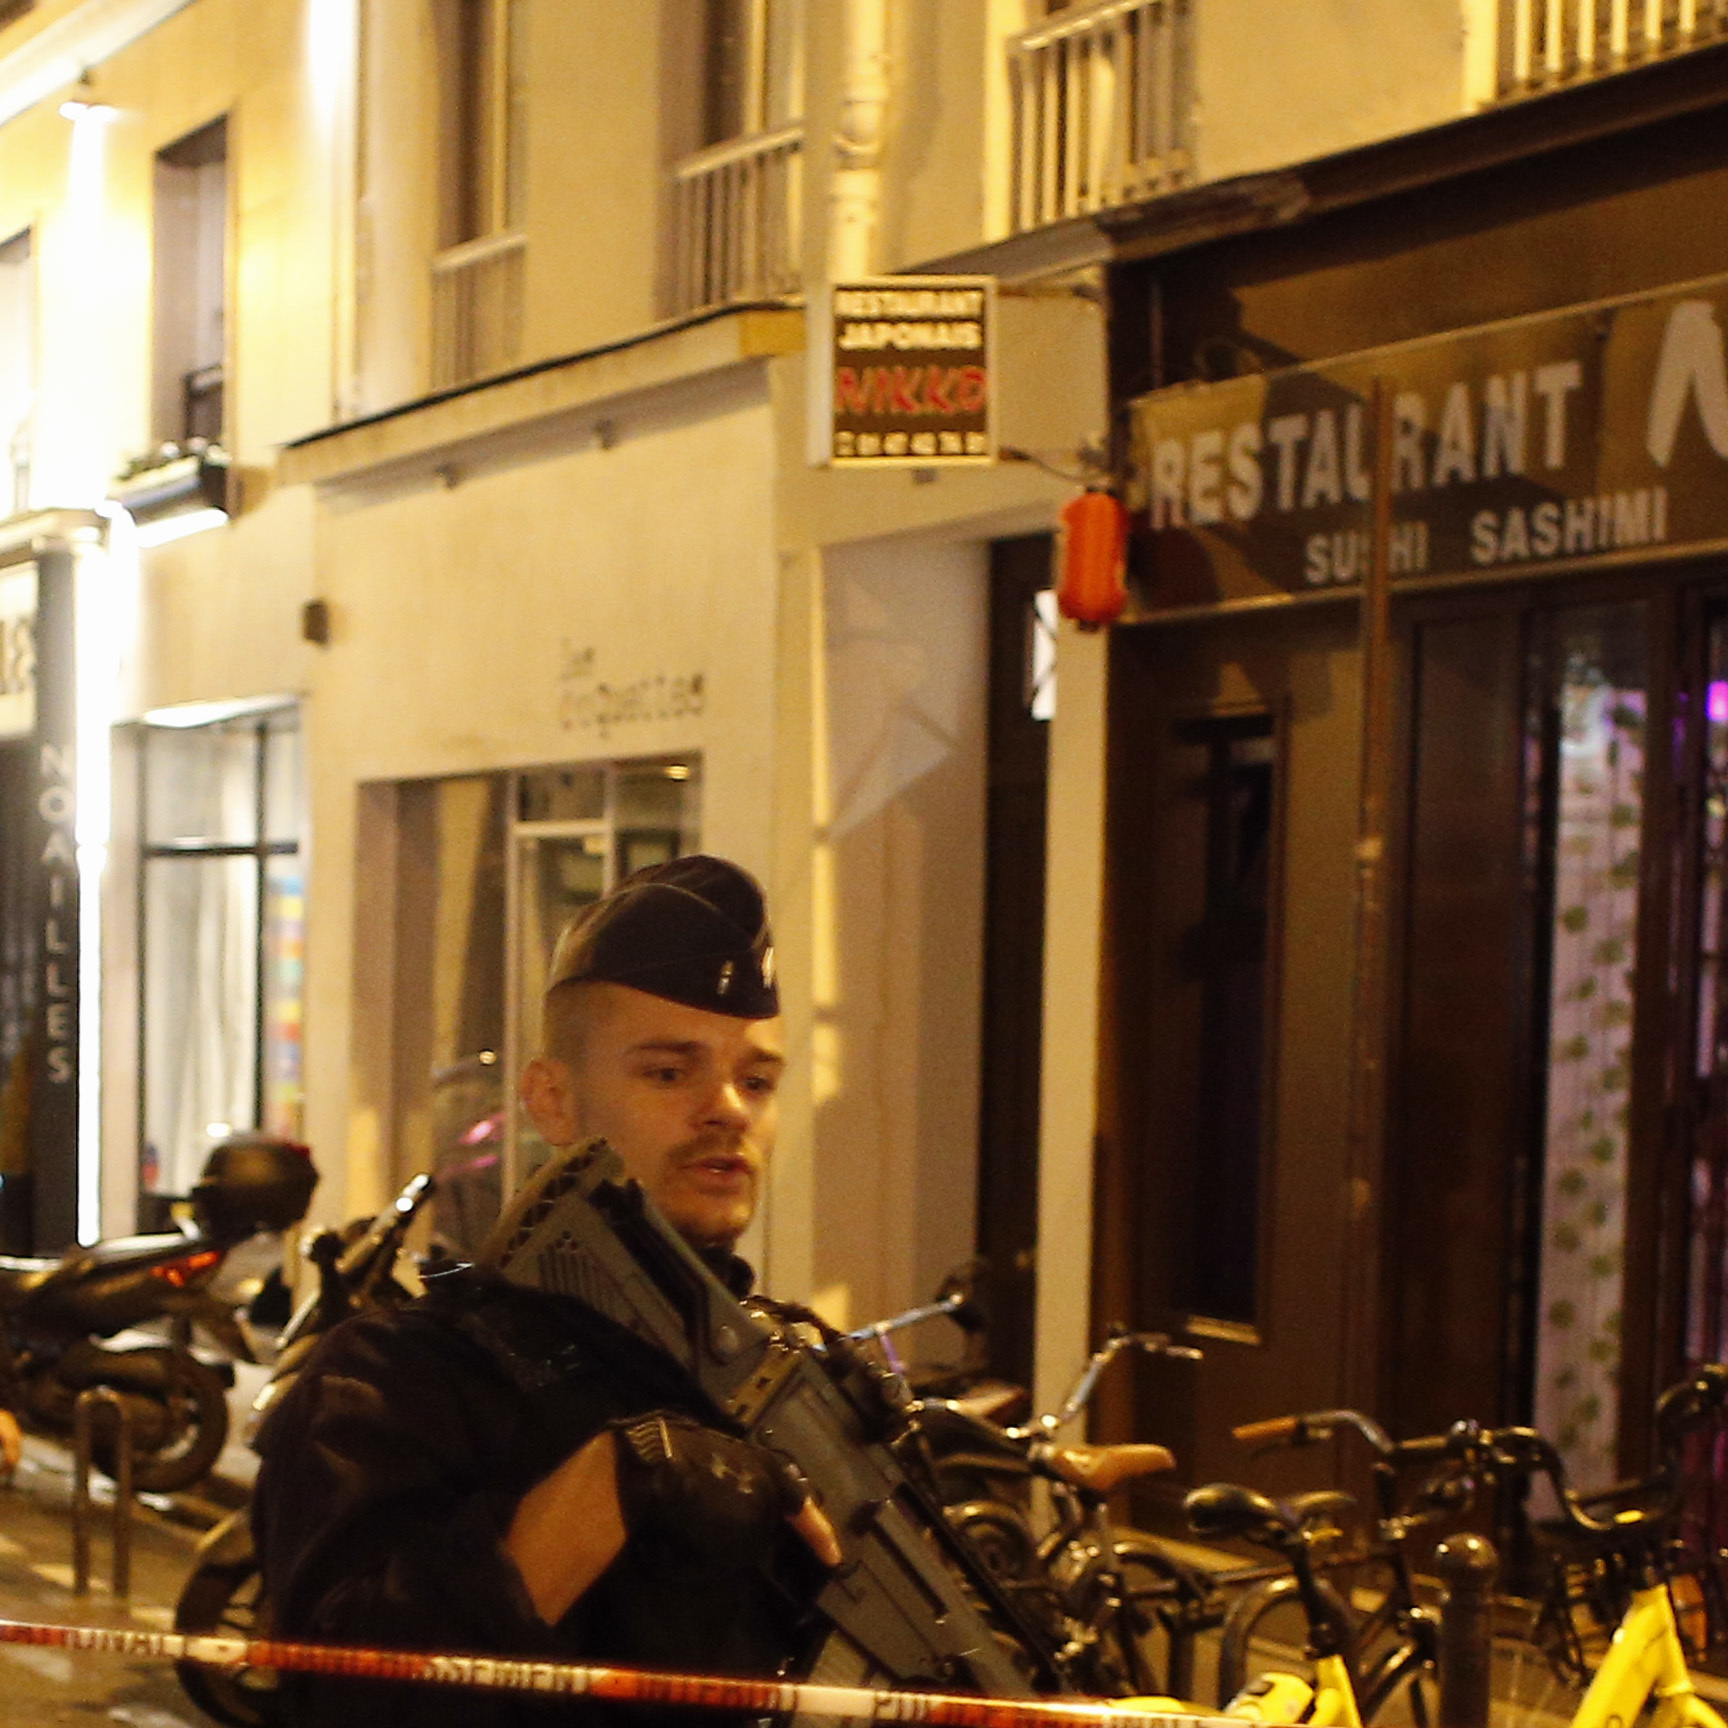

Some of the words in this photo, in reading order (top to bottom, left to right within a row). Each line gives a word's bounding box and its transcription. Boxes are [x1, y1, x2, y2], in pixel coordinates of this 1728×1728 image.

[835, 289, 984, 318] RESTAURANT
[838, 321, 983, 350] JAPONAIS
[835, 363, 987, 415] NIKKO
[1471, 487, 1668, 564] SASHIMI
[38, 744, 73, 1084] NOAILLES
